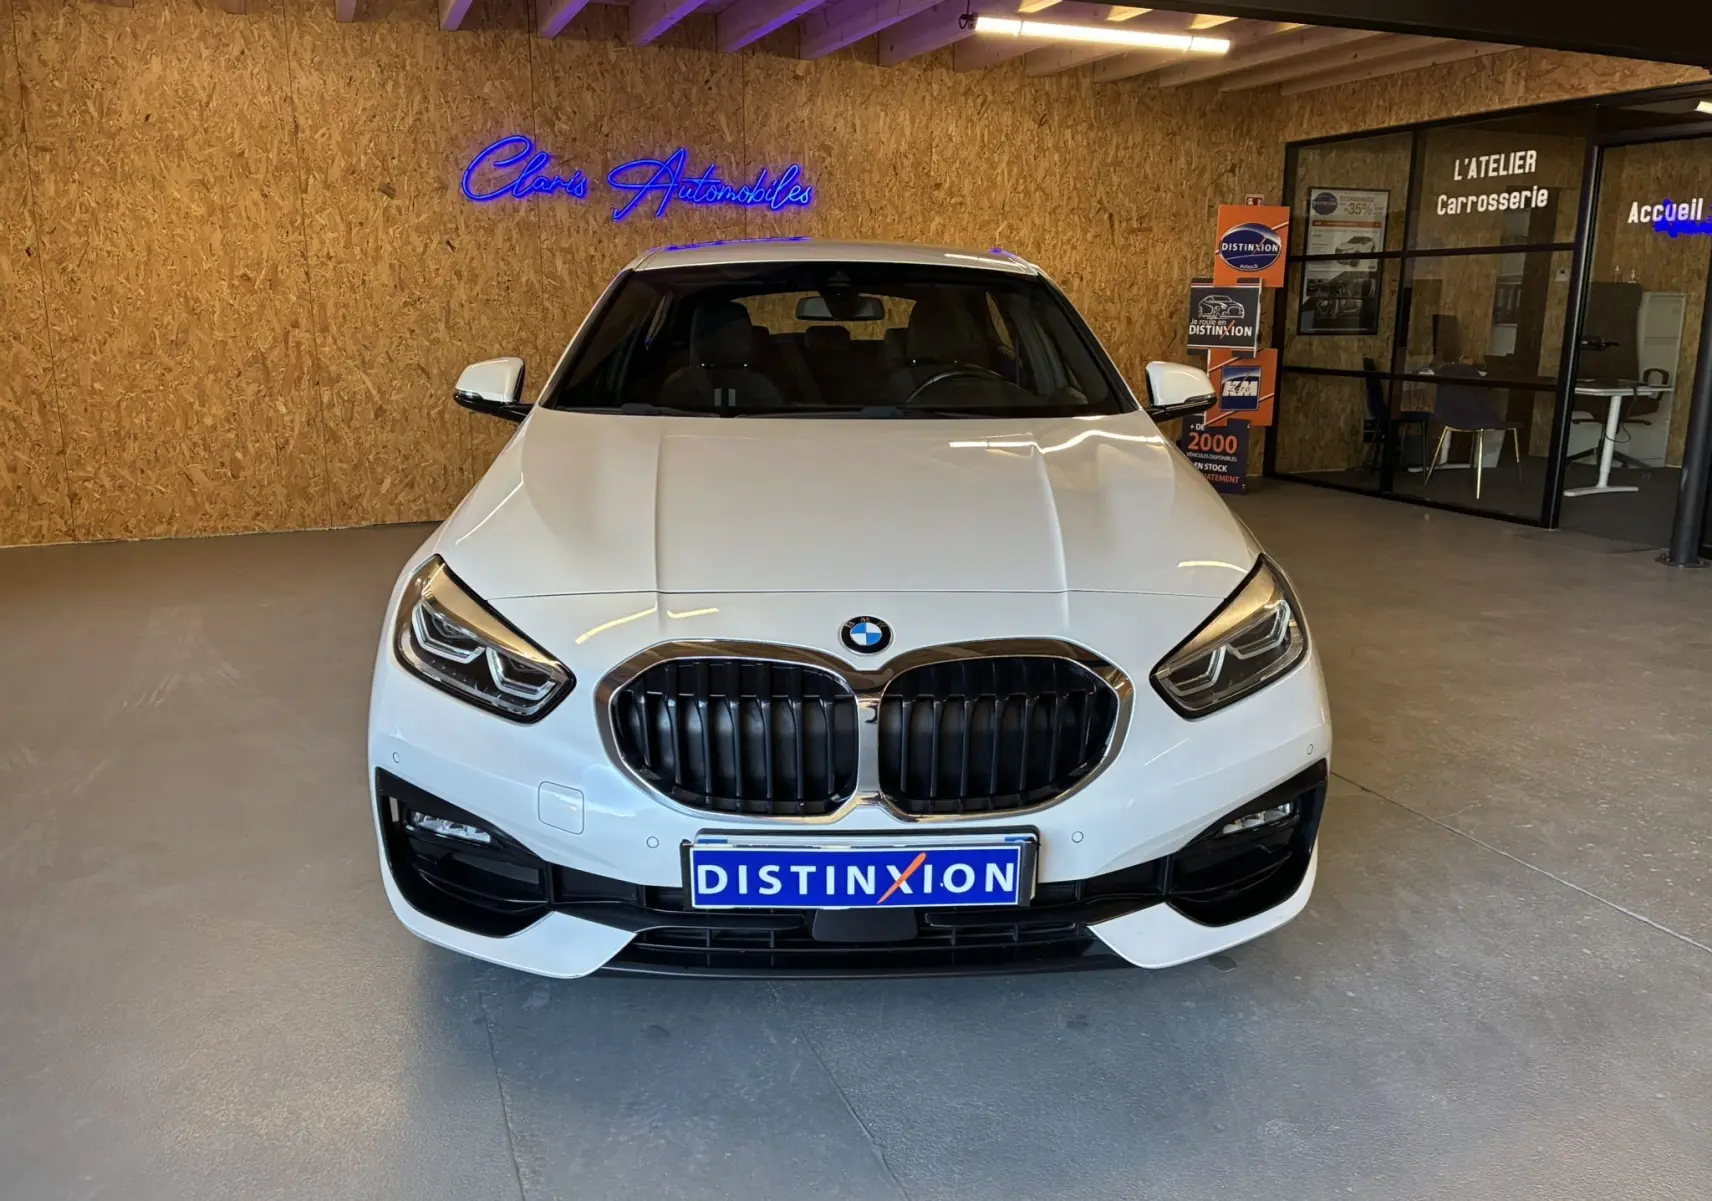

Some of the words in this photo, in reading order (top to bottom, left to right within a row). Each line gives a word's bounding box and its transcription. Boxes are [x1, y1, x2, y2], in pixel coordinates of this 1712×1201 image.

[461, 134, 588, 200] Claris
[607, 148, 814, 221] Automobiles
[1454, 149, 1538, 181] L'ATELIER
[1437, 185, 1549, 216] Carrosserie
[1627, 197, 1704, 224] Accueil
[1222, 241, 1279, 253] DISTINXION
[1189, 323, 1253, 338] DISTINXION
[1188, 431, 1238, 454] 2000
[1204, 463, 1228, 473] STOCK
[697, 857, 1015, 901] DISTINXION
